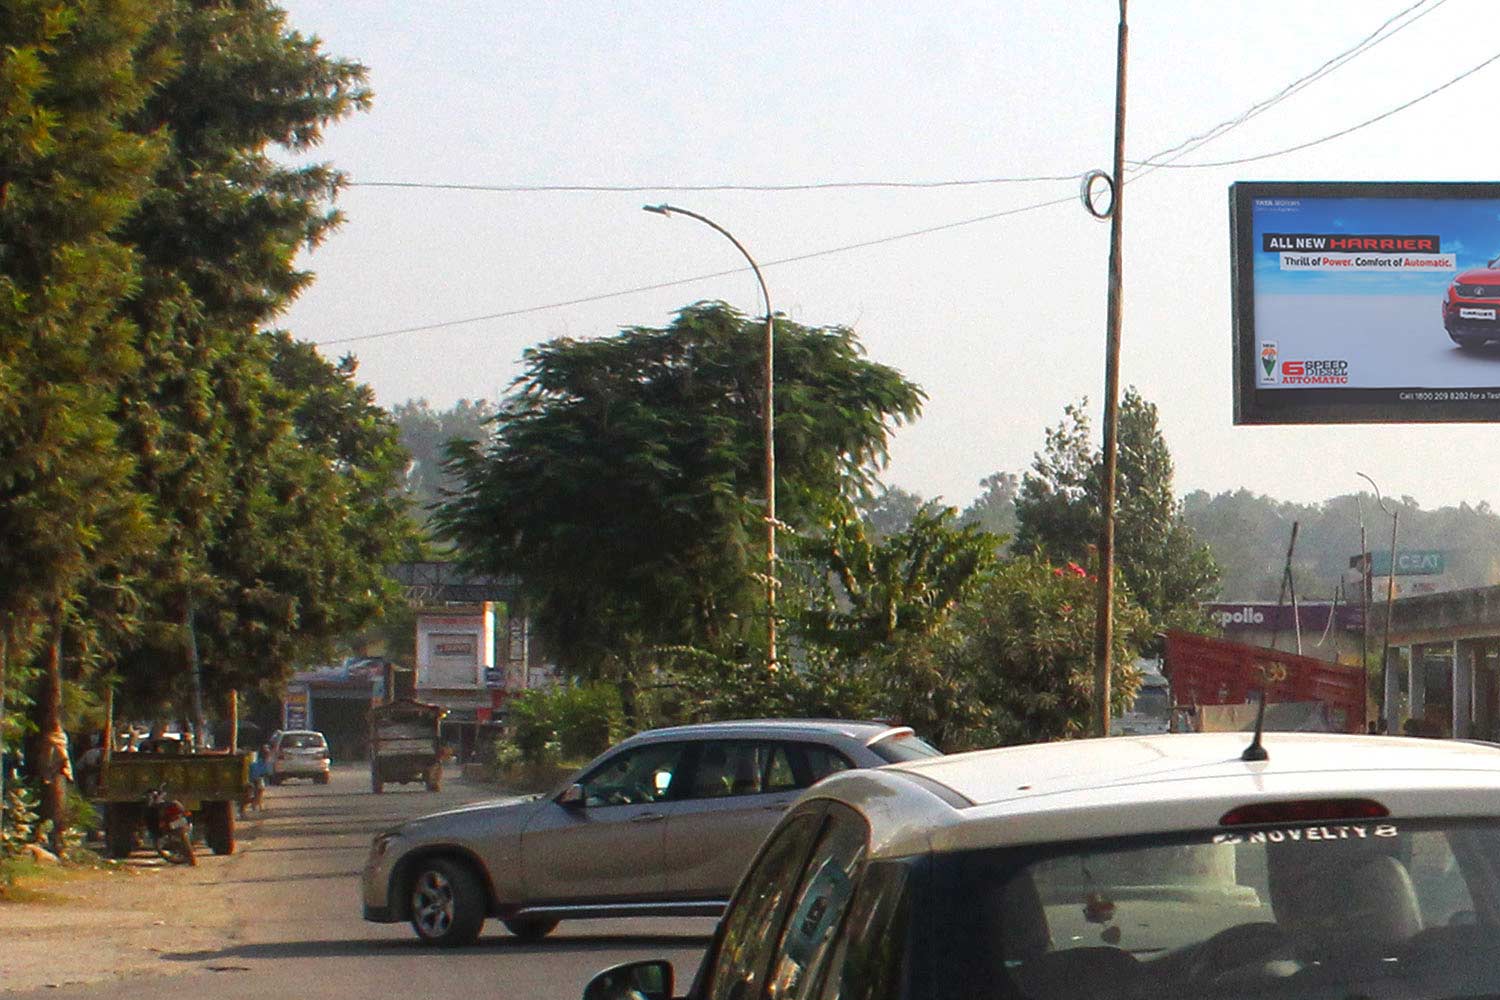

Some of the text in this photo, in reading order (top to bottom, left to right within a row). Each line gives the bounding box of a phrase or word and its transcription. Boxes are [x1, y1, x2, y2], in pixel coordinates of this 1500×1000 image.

[1270, 237, 1434, 250] ALL NEW HARRIER
[1284, 256, 1452, 267] Thrill of Power. Comfort of Automatic.
[1282, 361, 1305, 376] 6
[1305, 360, 1348, 370] SPEED
[1281, 376, 1348, 385] AUTOMATIC
[1399, 391, 1415, 400] Call
[1469, 391, 1480, 400] for
[1487, 391, 1500, 400] Test
[1249, 825, 1368, 844] NOVELTY
